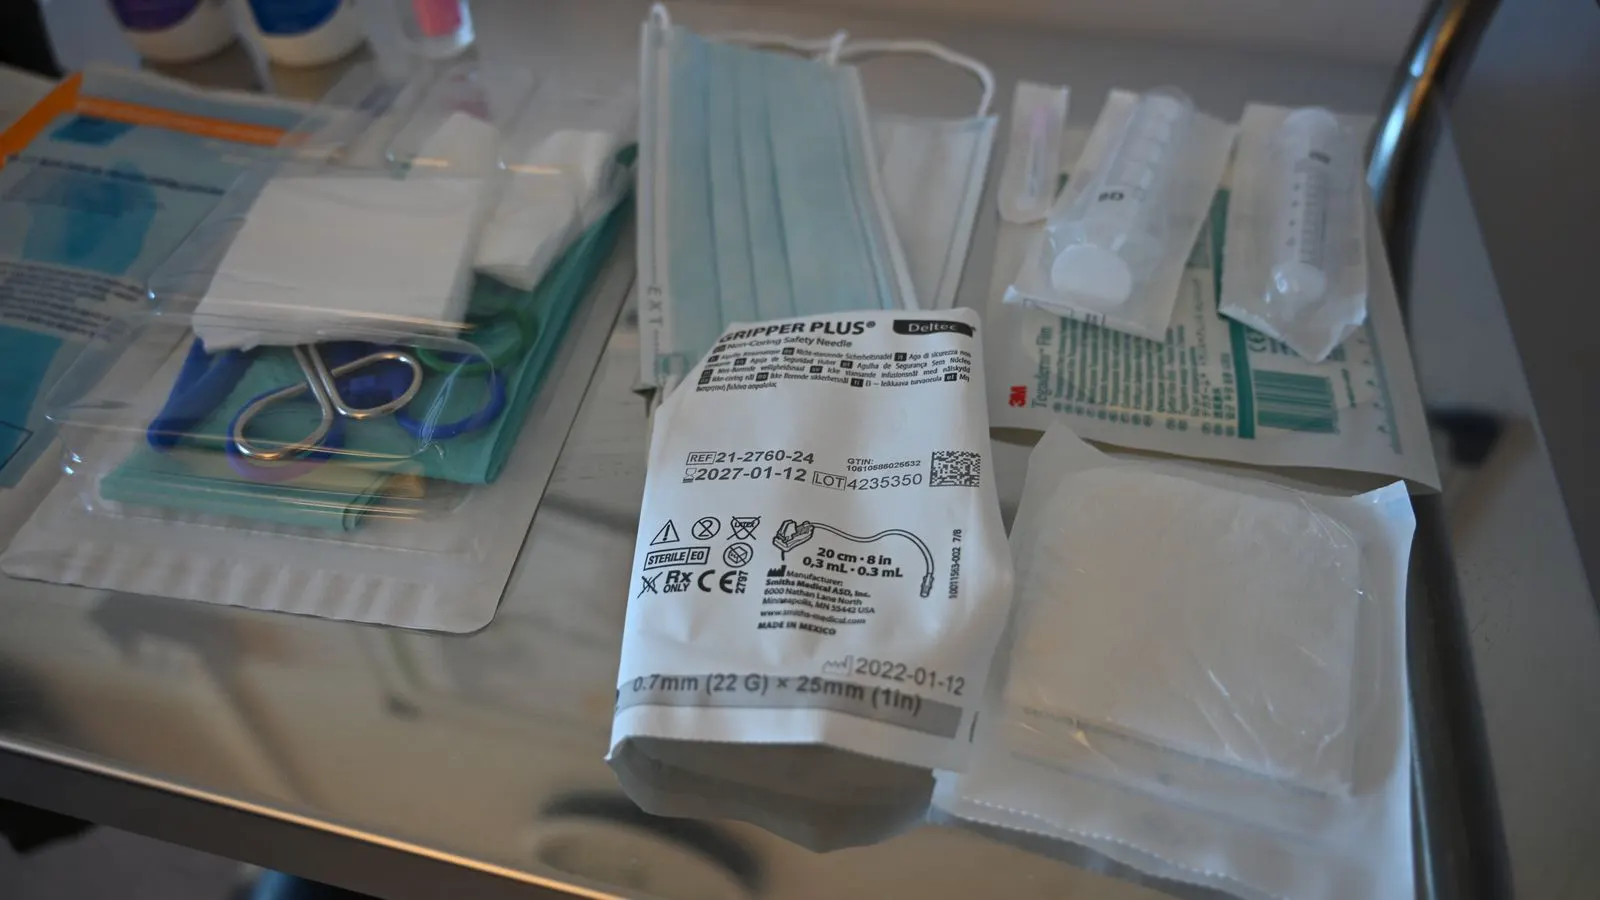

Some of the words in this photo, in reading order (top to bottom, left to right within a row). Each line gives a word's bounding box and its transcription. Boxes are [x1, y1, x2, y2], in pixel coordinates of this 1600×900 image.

[719, 322, 806, 343] GRIPPER
[908, 322, 957, 333] Deltec
[727, 338, 781, 350] Non-Coring
[784, 336, 816, 347] Safety
[816, 337, 852, 348] Needle
[1008, 385, 1027, 408] 3M
[689, 453, 713, 463] REF
[715, 449, 815, 464] 21-2760-24
[847, 457, 874, 465] GTIN:
[695, 466, 807, 482] 2027-01-12
[815, 473, 845, 488] LOT
[847, 473, 923, 491] 4235350
[952, 529, 962, 543] 7/8
[647, 551, 686, 566] STERILE
[690, 550, 705, 561] EO
[817, 547, 835, 558] 20
[836, 552, 857, 563] cm
[866, 555, 876, 565] 8
[878, 555, 892, 565] in
[802, 556, 824, 569] 0,3
[826, 563, 848, 574] mL
[857, 566, 879, 577] 0.3
[881, 567, 903, 578] mL
[666, 570, 693, 584] Rx
[735, 570, 749, 594] 2797
[786, 570, 844, 587] Manufacturer:
[663, 582, 690, 593] ONLY
[765, 578, 796, 587] Smiths
[796, 580, 831, 593] Medical
[831, 587, 853, 597] ASD,
[854, 590, 871, 598] Inc.
[764, 587, 784, 596] 6000
[785, 588, 815, 599] Nathan
[816, 592, 837, 602] Lane
[838, 596, 862, 606] North
[815, 601, 830, 611] MN
[831, 604, 857, 614] 55442
[858, 606, 876, 615] USA
[757, 621, 784, 630] MADE
[786, 620, 797, 629] IN
[799, 622, 837, 636] MEXICO
[855, 657, 966, 696] 2022-01-12
[633, 674, 699, 692] 0.7mm
[706, 673, 737, 696] (22
[744, 673, 769, 696] G)
[796, 675, 865, 701] 25mm
[872, 686, 922, 717] (1in)
